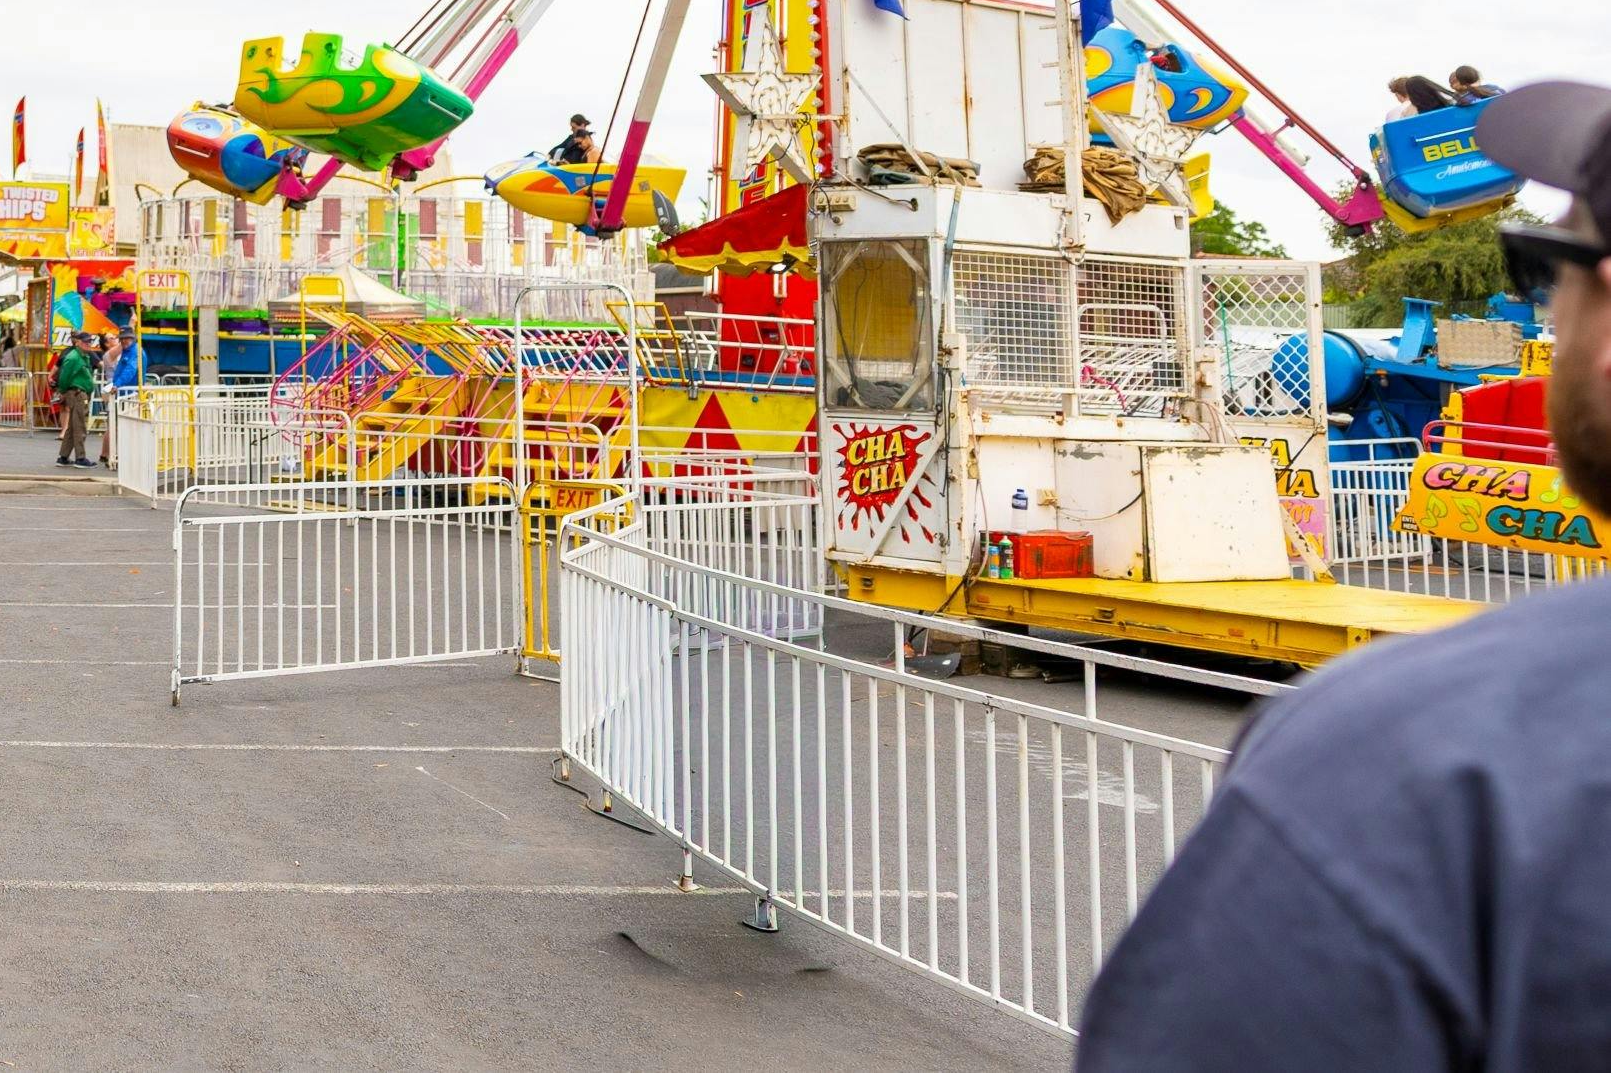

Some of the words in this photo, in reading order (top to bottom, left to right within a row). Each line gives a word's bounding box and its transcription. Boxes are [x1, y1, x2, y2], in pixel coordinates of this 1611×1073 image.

[3, 186, 59, 203] TWISTED
[148, 273, 177, 287] EXIT
[847, 430, 906, 466] CHA
[852, 461, 907, 496] CHA
[1423, 461, 1532, 502] CHA
[556, 488, 595, 509] EXIT
[1486, 504, 1602, 549] CHA
